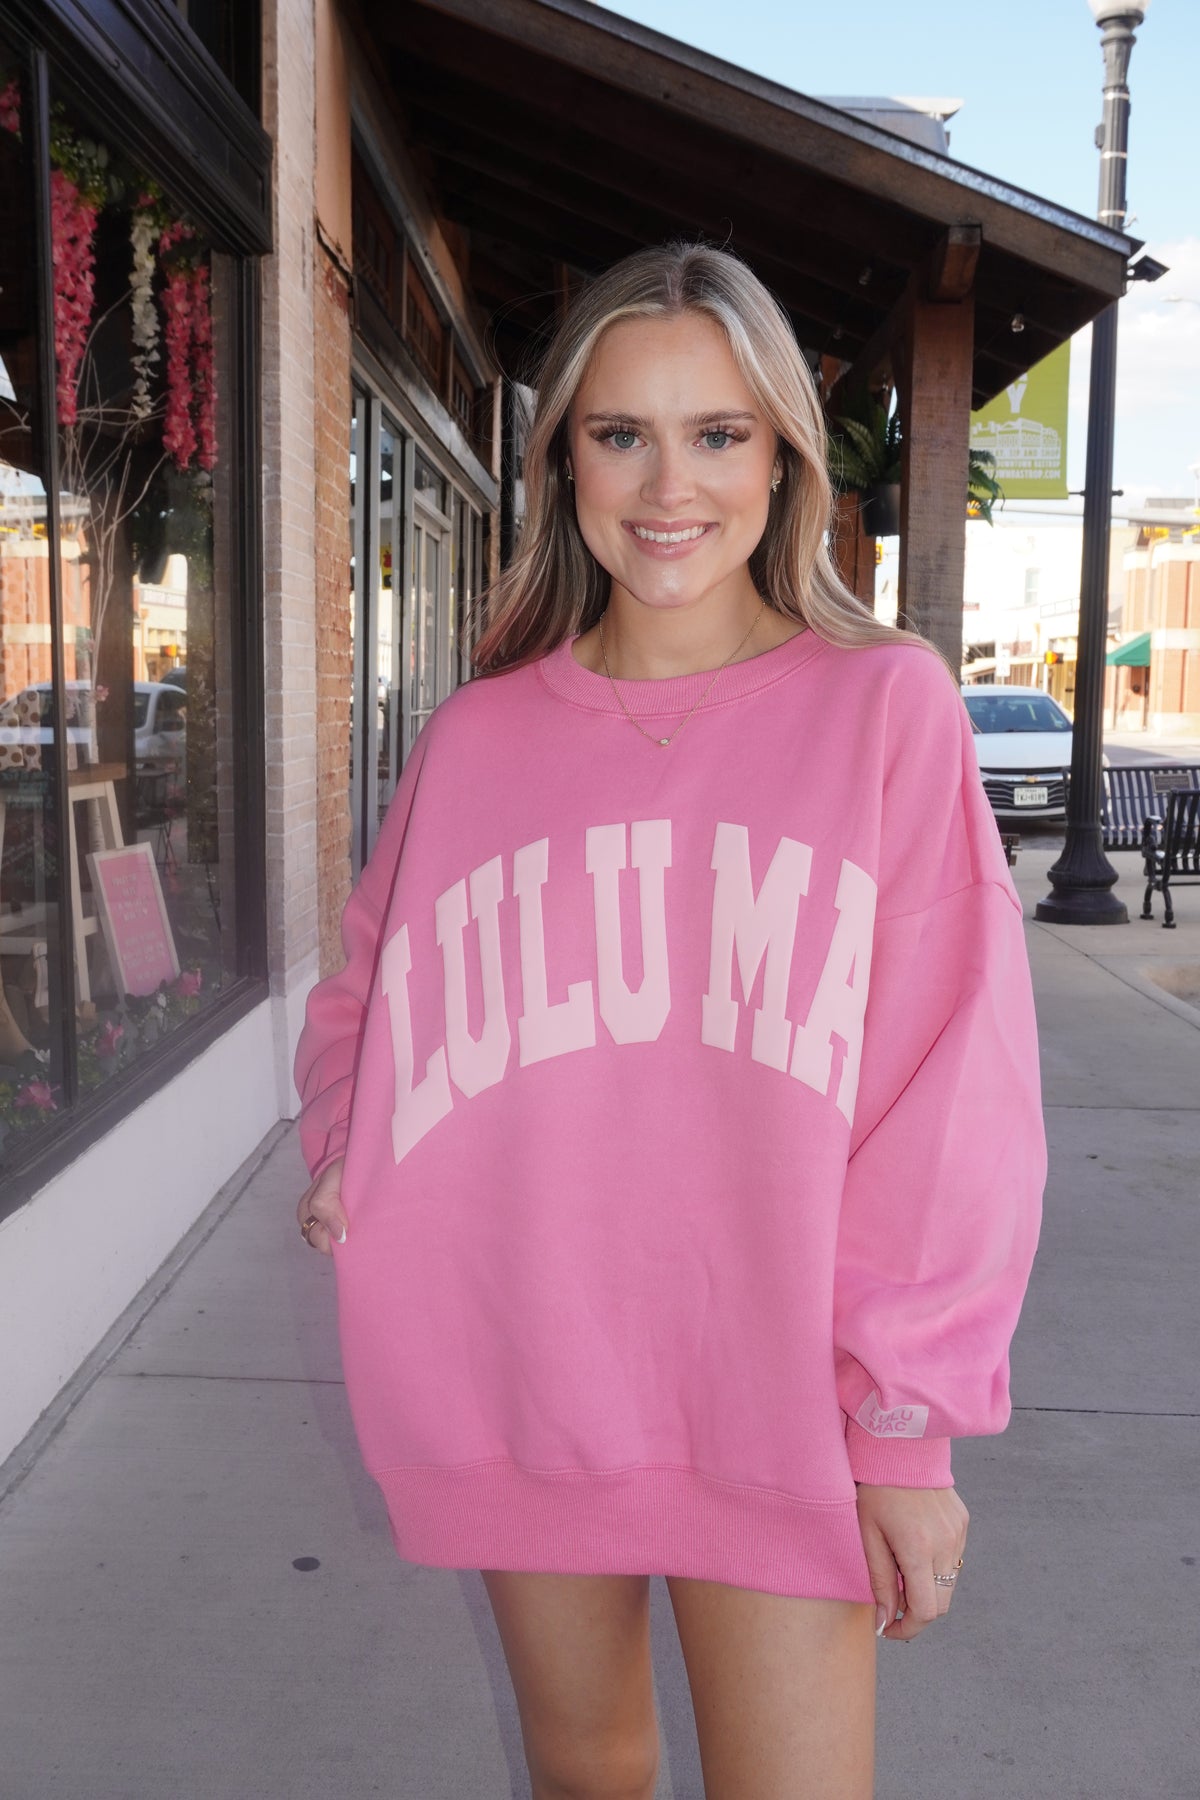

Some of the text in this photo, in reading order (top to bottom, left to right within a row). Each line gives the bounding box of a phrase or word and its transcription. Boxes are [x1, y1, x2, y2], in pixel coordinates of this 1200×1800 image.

[1024, 449, 1038, 457] AND
[381, 819, 878, 1165] LULU MA
[869, 1407, 914, 1424] LULU
[868, 1421, 907, 1434] MAC
